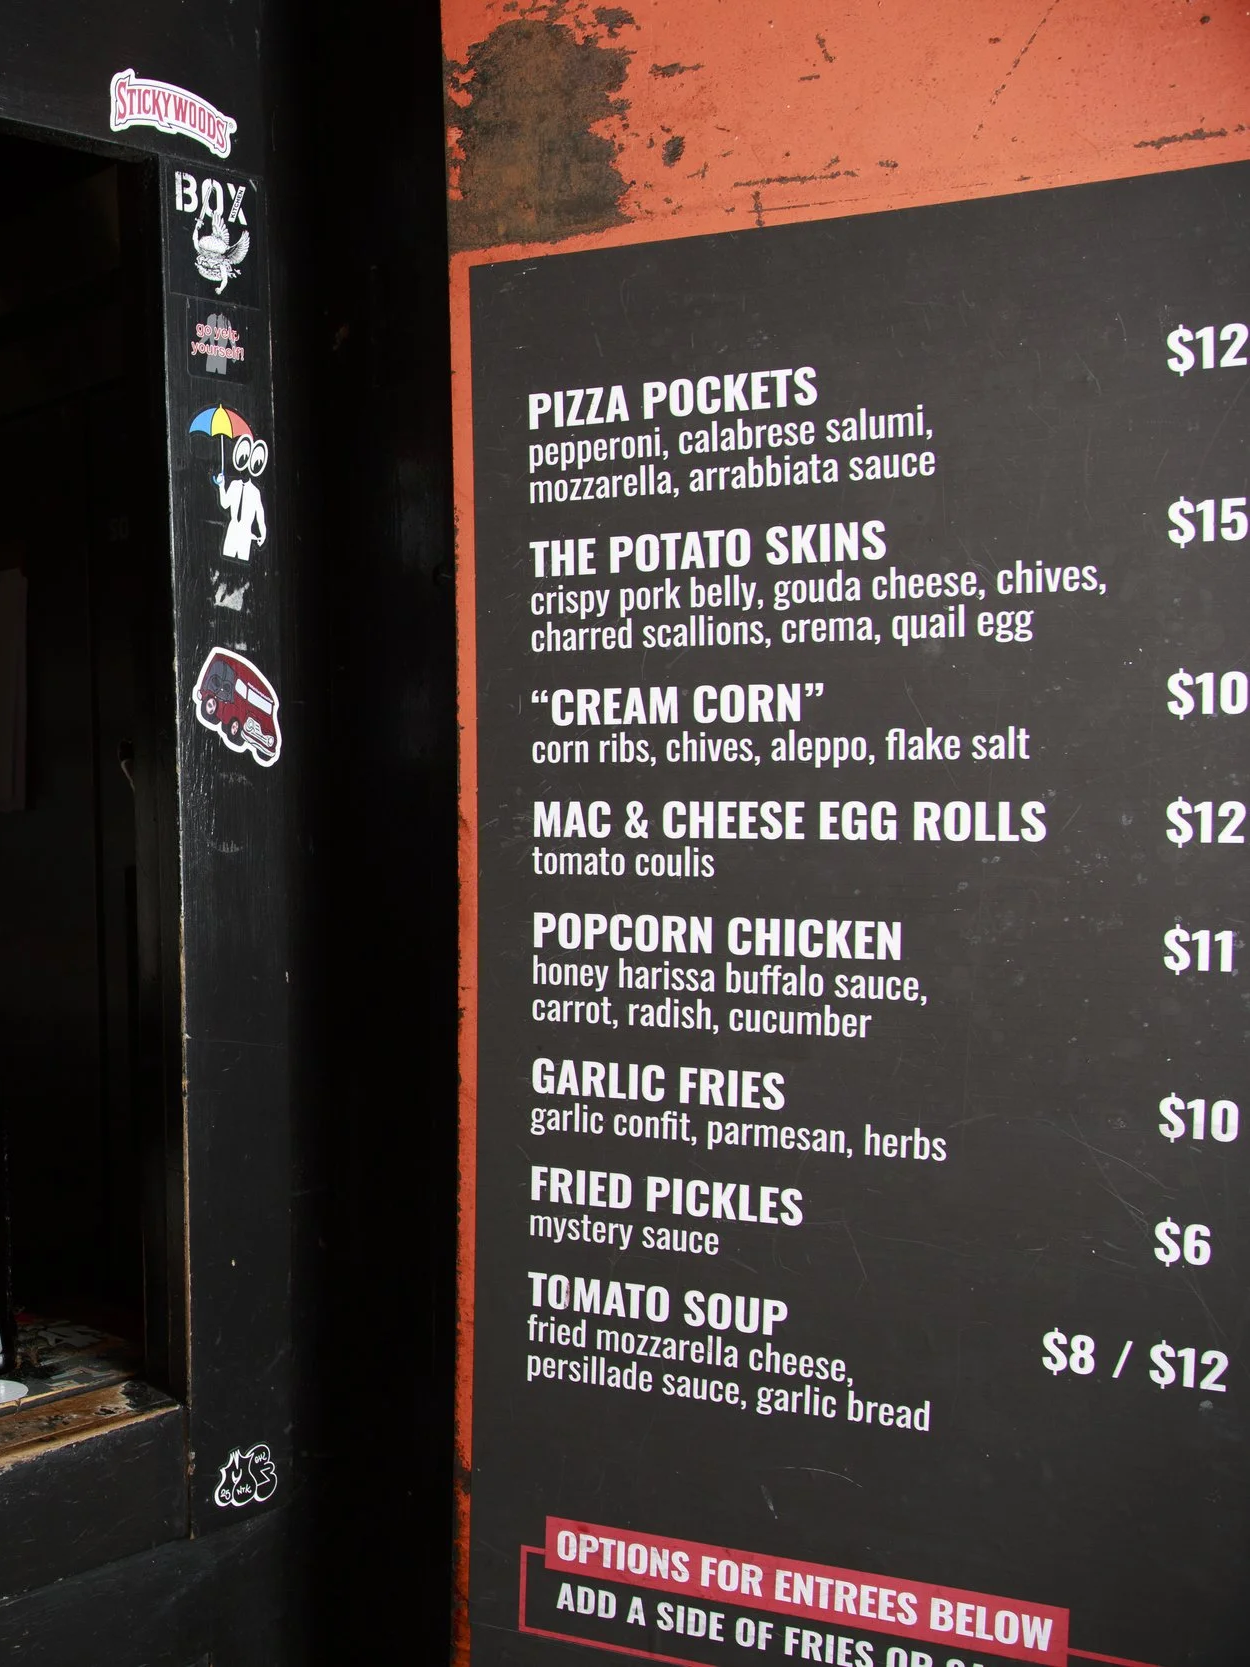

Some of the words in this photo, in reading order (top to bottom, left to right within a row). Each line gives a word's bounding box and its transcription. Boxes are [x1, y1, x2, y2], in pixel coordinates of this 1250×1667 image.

[117, 80, 226, 149] STICKYWOODS
[174, 170, 248, 226] BOX
[191, 341, 245, 361] yourself!
[195, 323, 212, 338] go
[214, 325, 240, 344] yelp
[1166, 322, 1249, 378] $12
[528, 384, 630, 431] PIZZA
[642, 366, 818, 420] POCKETS
[528, 426, 669, 474] pepperoni,
[678, 418, 816, 455] calabrese
[825, 403, 933, 444] salumi,
[529, 463, 680, 504] mozzarella,
[689, 453, 839, 493] arrabbiata
[848, 451, 936, 482] sauce
[529, 537, 597, 578] THE
[609, 527, 751, 574] POTATO
[765, 519, 887, 566] SKINS
[1167, 495, 1249, 550] $15
[530, 584, 611, 620] crispy
[619, 577, 681, 618] pork
[690, 573, 764, 612] belly,
[773, 568, 861, 611] gouda
[871, 566, 986, 601] cheese,
[996, 559, 1107, 596] chives,
[531, 617, 633, 653] charred
[642, 614, 772, 649] scallions,
[781, 616, 881, 645] crema,
[891, 603, 966, 647] quail
[976, 609, 1035, 643] egg
[1166, 667, 1249, 721] $10
[531, 740, 589, 764] corn
[599, 731, 657, 767] ribs,
[665, 730, 761, 767] chives,
[770, 728, 876, 769] aleppo,
[884, 726, 961, 761] flake
[971, 725, 1031, 760] salt
[533, 800, 612, 839] MAC
[624, 800, 649, 839] &
[662, 800, 806, 841] CHEESE
[819, 800, 897, 842] EGG
[913, 800, 1047, 843] ROLLS
[1165, 795, 1247, 849] $12
[531, 846, 626, 877] tomato
[635, 845, 715, 879] coulis
[533, 911, 713, 954] POPCORN
[727, 916, 902, 961] CHICKEN
[1163, 923, 1235, 976] $11
[532, 954, 610, 993] honey
[618, 957, 715, 993] harissa
[725, 961, 824, 998] buffalo
[833, 974, 927, 1007] sauce,
[532, 996, 619, 1030] carrot,
[628, 996, 719, 1035] radish,
[729, 1004, 873, 1039] cucumber
[532, 1057, 666, 1102] GARLIC
[679, 1066, 786, 1111] FRIES
[530, 1102, 604, 1136] garlic
[613, 1110, 697, 1146] confit,
[707, 1120, 853, 1159] parmesan,
[864, 1123, 947, 1162] herbs
[1158, 1091, 1239, 1144] $10
[530, 1165, 632, 1210] FRIED
[646, 1175, 804, 1227] PICKLES
[529, 1214, 634, 1251] mystery
[641, 1226, 719, 1256] sauce
[1153, 1216, 1211, 1268] $6
[527, 1271, 670, 1323] TOMATO
[683, 1289, 788, 1336] SOUP
[527, 1313, 589, 1348] fried
[596, 1328, 738, 1369] mozzarella
[748, 1342, 853, 1388] cheese,
[1041, 1327, 1095, 1376] $8
[1149, 1339, 1229, 1393] $12
[526, 1354, 653, 1393] persillade
[661, 1373, 747, 1410] sauce,
[755, 1384, 837, 1419] garlic
[847, 1390, 931, 1432] bread
[556, 1530, 690, 1583] OPTIONS
[700, 1555, 764, 1598] FOR
[774, 1569, 918, 1626] ENTREES
[929, 1596, 1053, 1652] BELOW
[556, 1582, 617, 1619] ADD
[626, 1596, 646, 1627] A
[656, 1601, 725, 1642] SIDE
[735, 1617, 774, 1651] OF
[784, 1626, 874, 1667] FRIES
